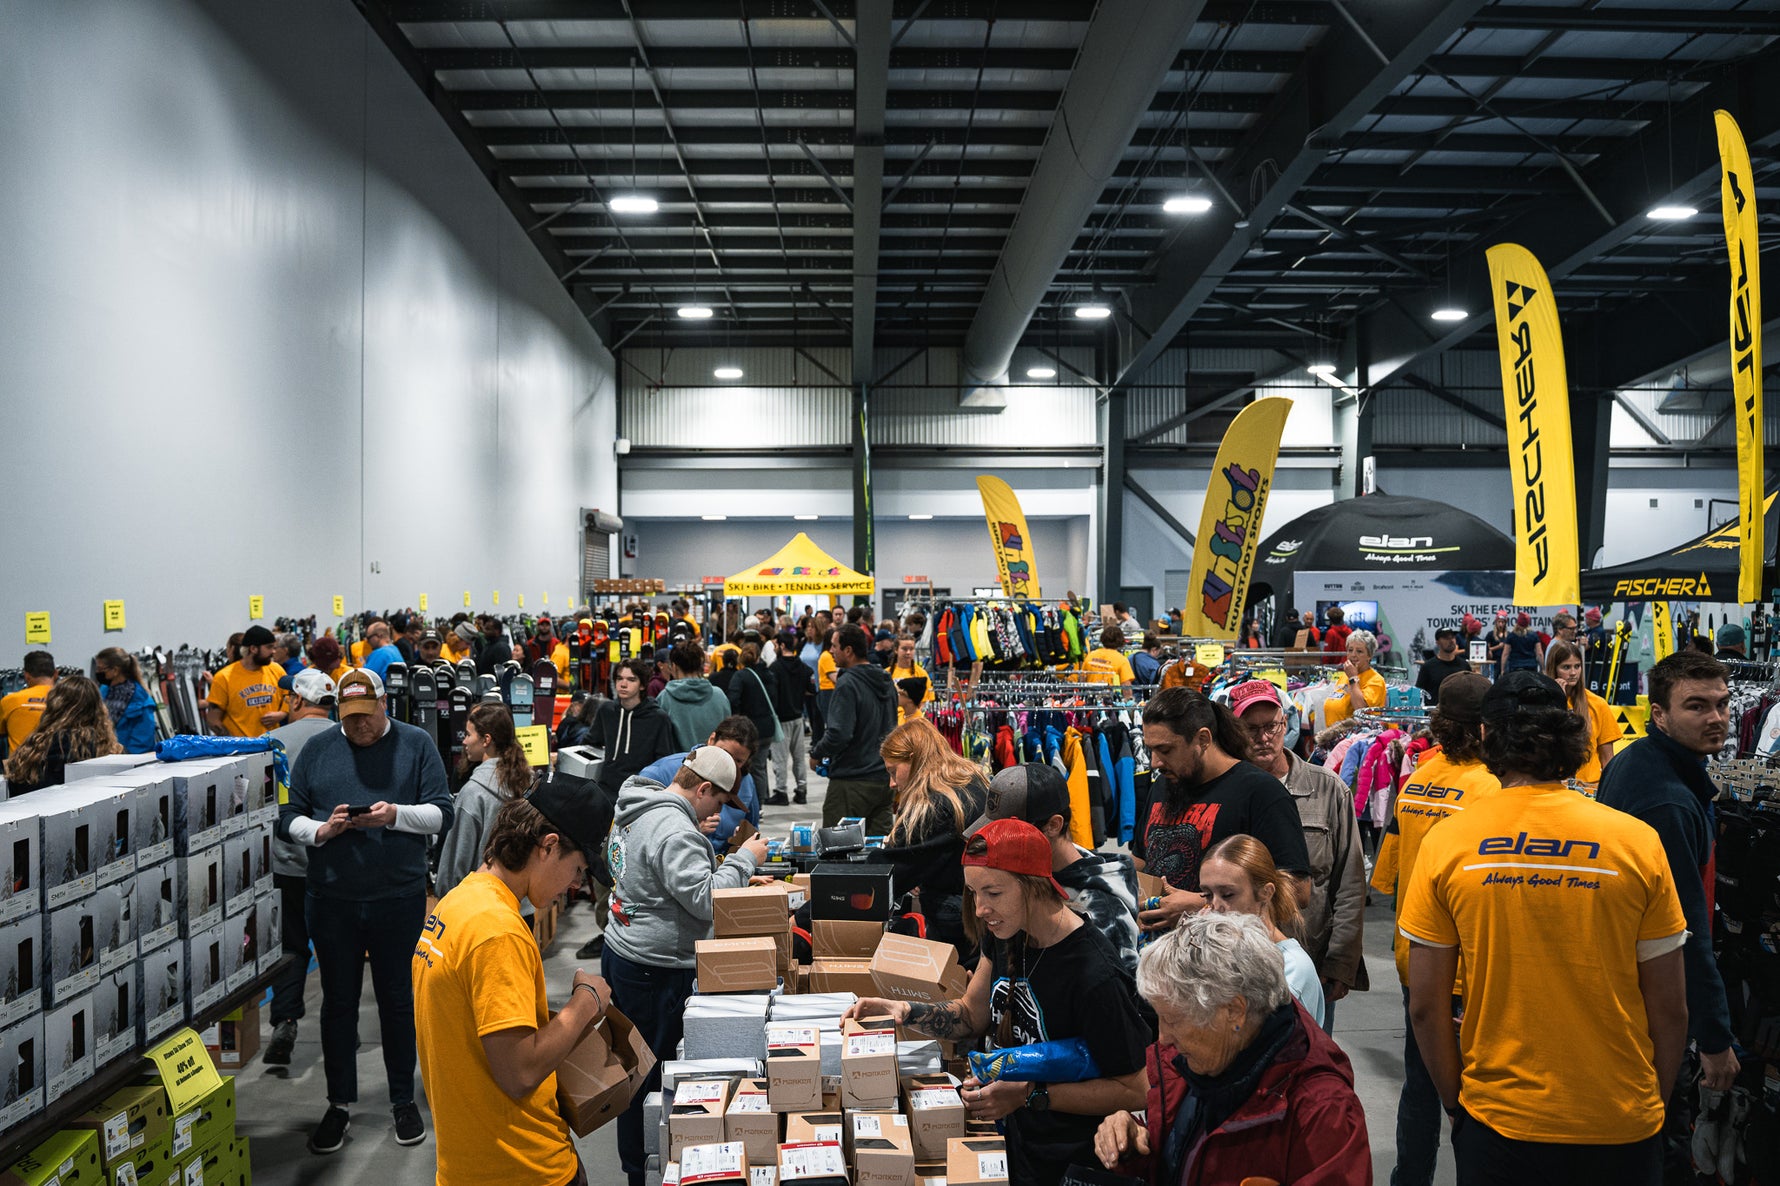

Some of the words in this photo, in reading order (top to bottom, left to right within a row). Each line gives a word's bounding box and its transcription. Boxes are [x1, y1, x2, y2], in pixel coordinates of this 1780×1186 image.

[1359, 535, 1433, 548] elan
[1229, 545, 1253, 632] KUNSTADT
[1250, 479, 1269, 538] SPORTS
[1614, 578, 1696, 596] FISCHER
[1451, 605, 1468, 614] SKI
[1470, 605, 1489, 614] THE
[1492, 605, 1537, 614] EASTERN
[1404, 782, 1464, 800] elan
[1400, 805, 1424, 817] Always
[1426, 808, 1442, 818] Good
[1478, 832, 1600, 859] elan
[1482, 872, 1524, 894] Always
[1528, 874, 1563, 888] Good
[1567, 877, 1600, 890] Times
[890, 986, 932, 1000] SMITH
